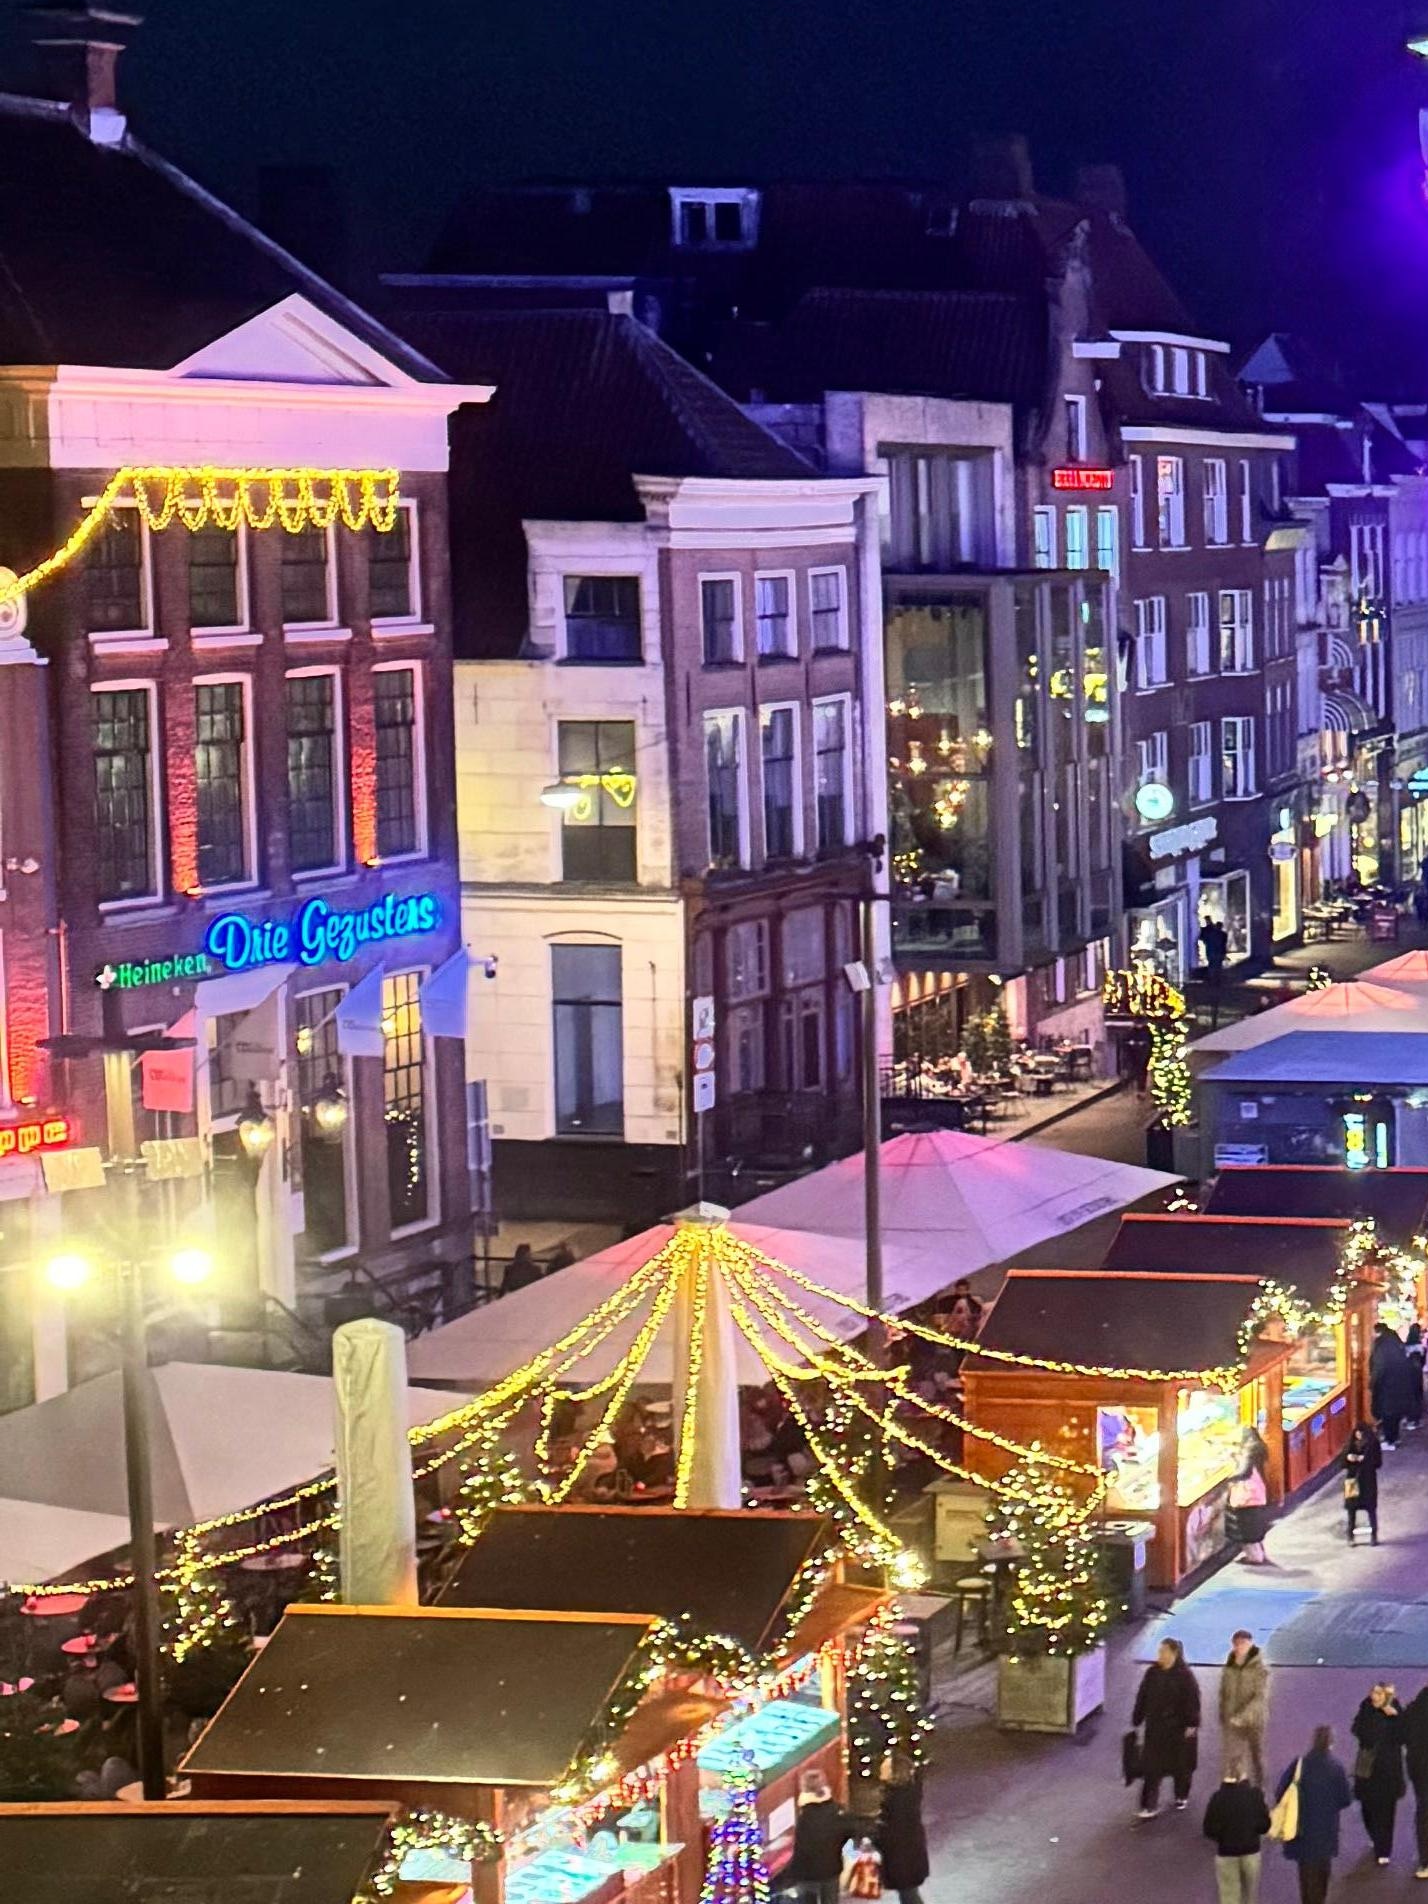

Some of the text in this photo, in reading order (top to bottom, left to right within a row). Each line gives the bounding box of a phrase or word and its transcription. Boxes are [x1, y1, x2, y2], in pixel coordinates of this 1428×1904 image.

[209, 894, 437, 969] Drie Gezusters
[118, 953, 207, 989] Heineken
